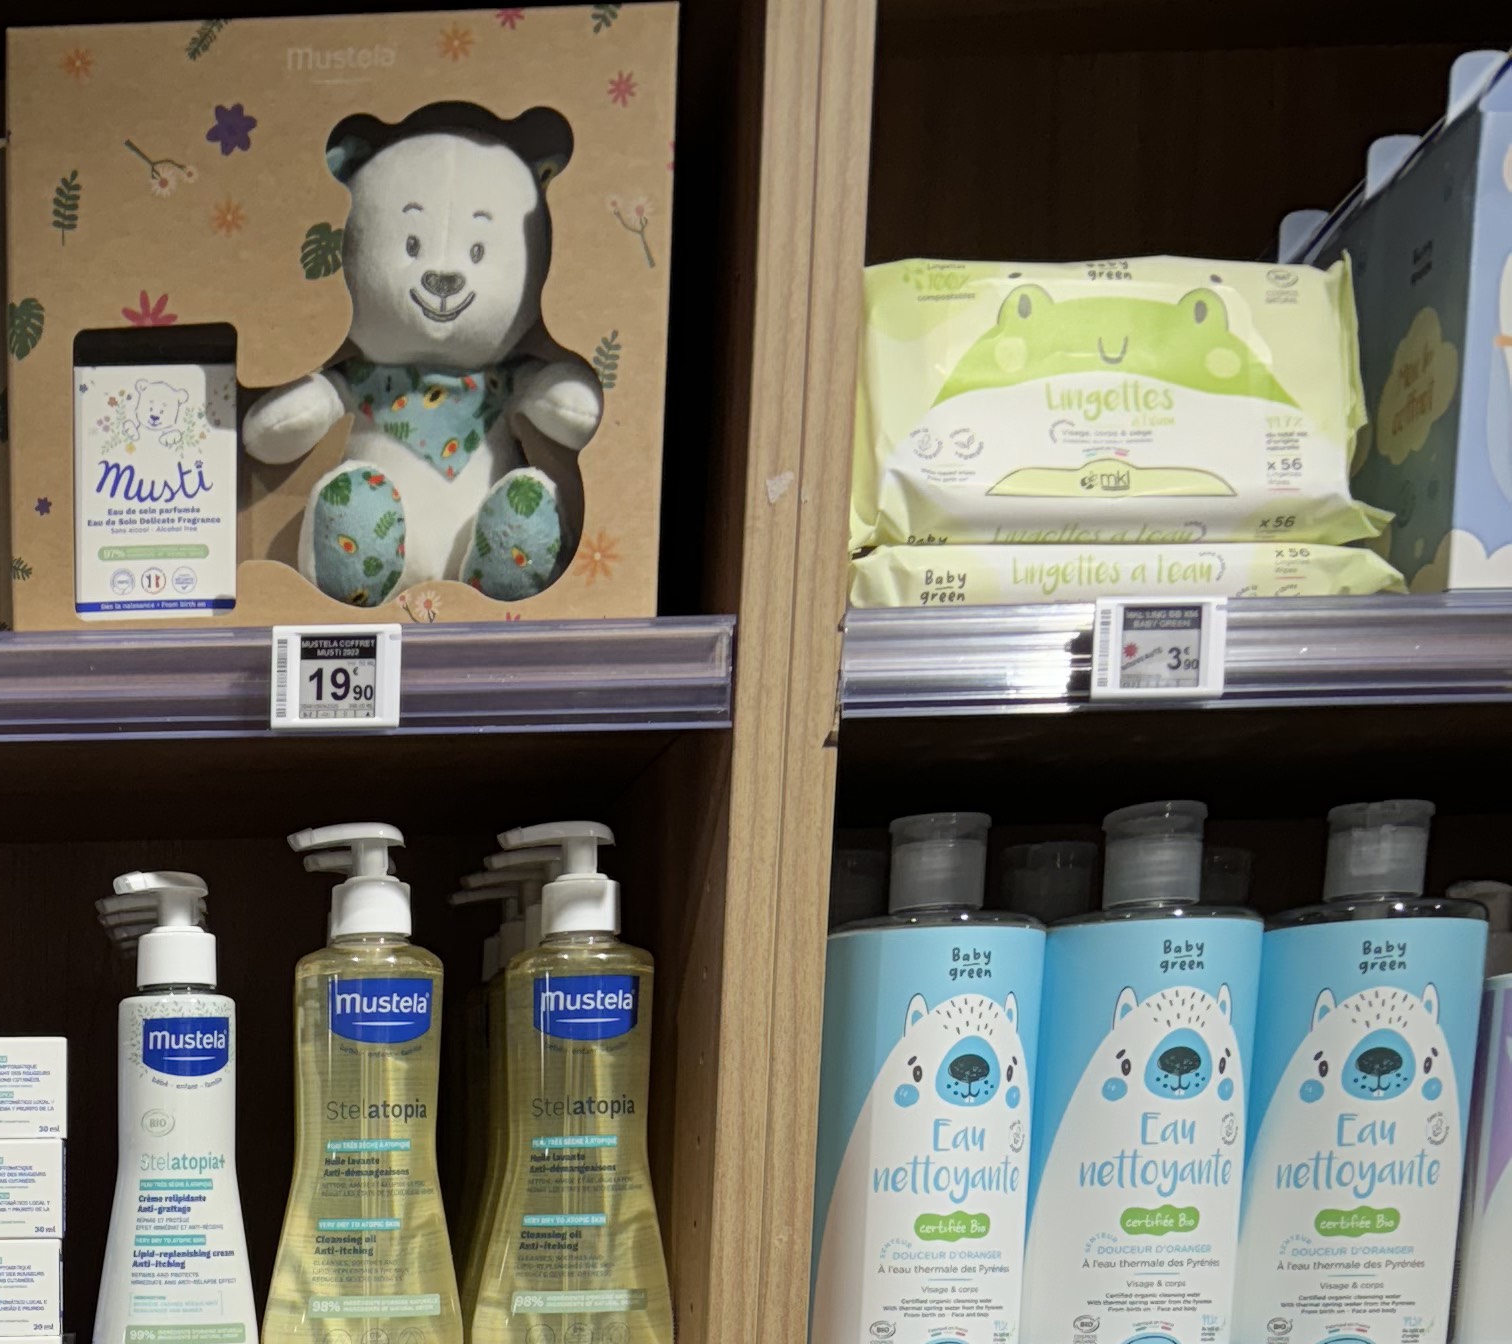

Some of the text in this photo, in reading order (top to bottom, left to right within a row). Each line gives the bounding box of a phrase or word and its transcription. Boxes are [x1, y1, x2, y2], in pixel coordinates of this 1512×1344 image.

[1046, 381, 1174, 421] Lingettes
[96, 460, 213, 502] Musti
[925, 570, 967, 587] Baby
[921, 591, 965, 604] green
[952, 947, 992, 966] Baby
[1163, 939, 1205, 958] Baby
[1363, 939, 1407, 958] Baby
[950, 966, 992, 981] green
[1160, 957, 1205, 972] green
[1359, 957, 1407, 972] green
[149, 1028, 227, 1052] Mustela
[327, 1099, 428, 1123] Stelatopia
[532, 1096, 636, 1119] Stelatopia
[933, 1117, 986, 1153] Eau
[1141, 1111, 1197, 1146] Eau
[1337, 1113, 1396, 1146] Eau
[874, 1153, 1020, 1204] nettoyante
[1079, 1147, 1232, 1197] nettoyante
[1276, 1149, 1441, 1199] nettoyante
[1098, 1245, 1152, 1254] DOUCEUR
[1119, 1258, 1163, 1267] thermale
[1167, 1258, 1183, 1267] des
